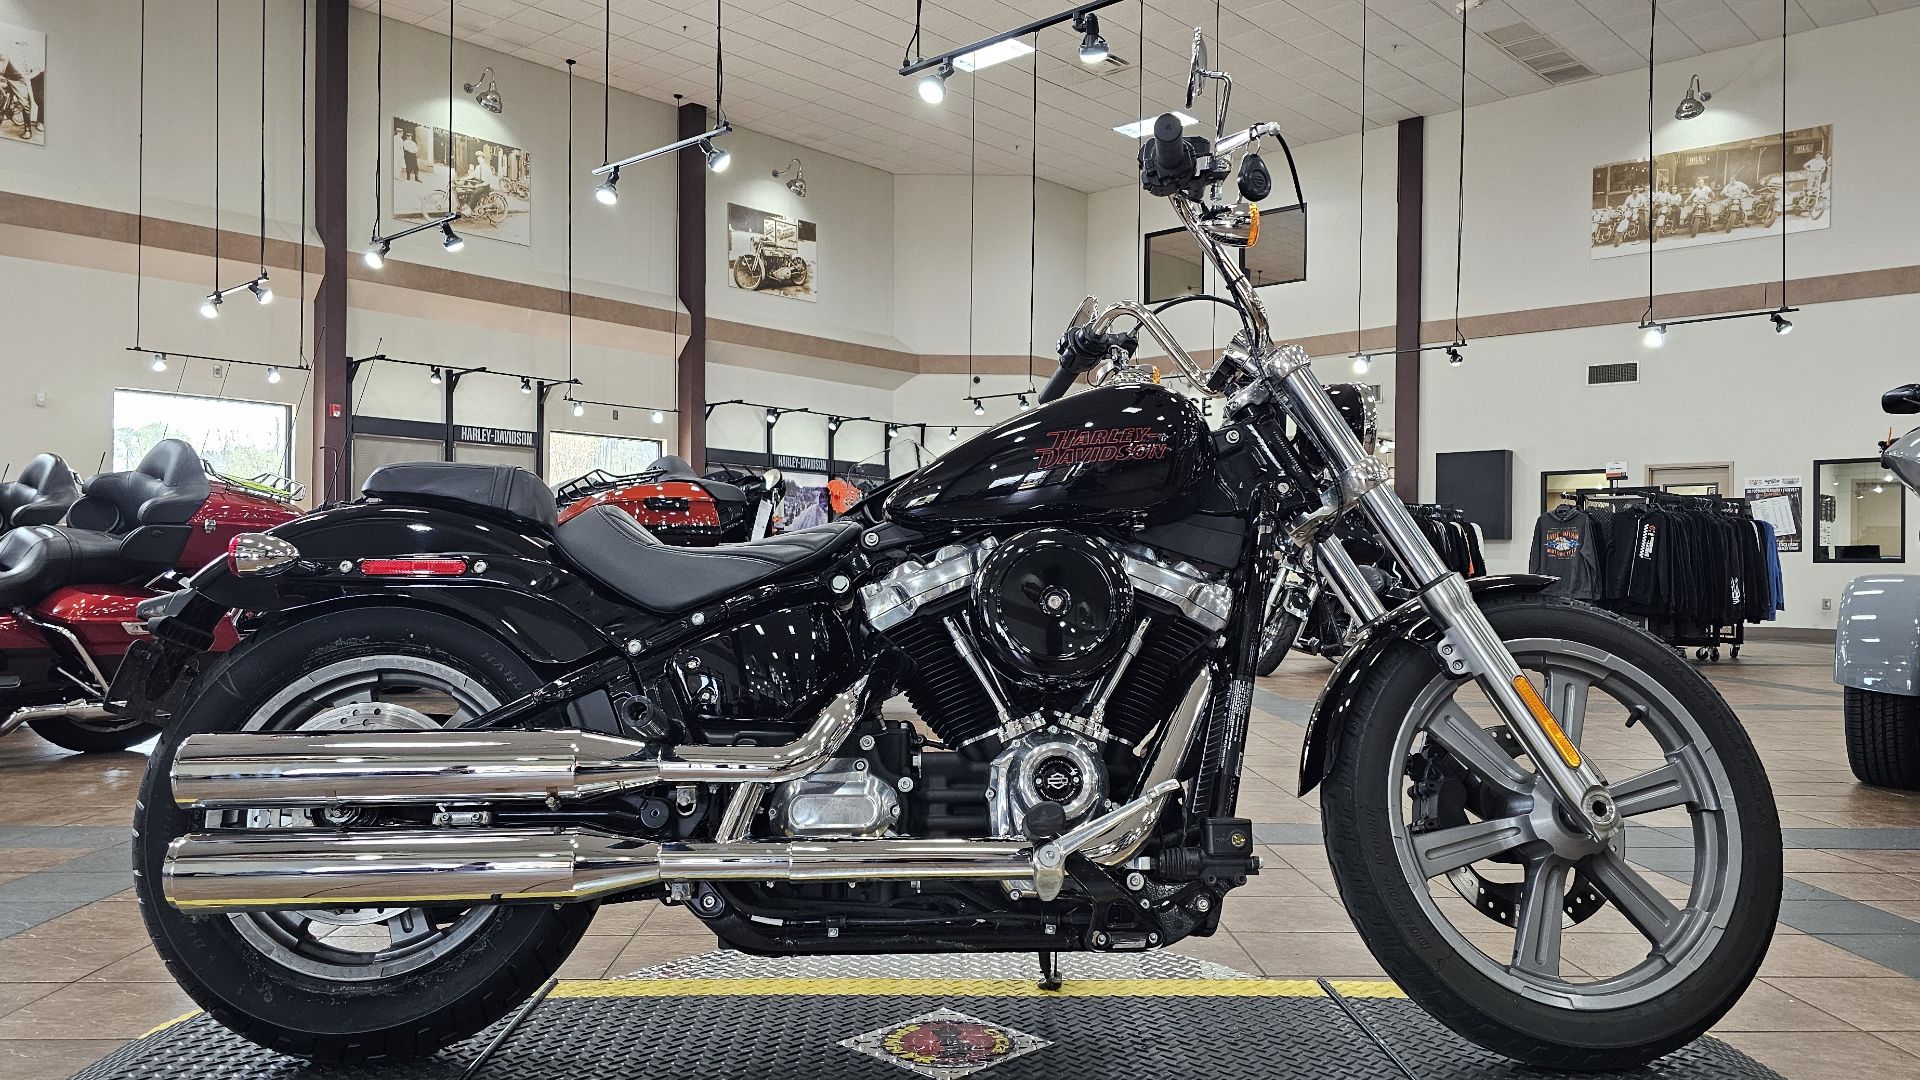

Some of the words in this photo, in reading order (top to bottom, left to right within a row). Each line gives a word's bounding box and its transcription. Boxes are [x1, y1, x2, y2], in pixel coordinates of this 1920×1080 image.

[461, 426, 533, 446] HARLEY-DAVIDSON
[778, 456, 827, 470] HARLEY-DAVIDSON
[1035, 443, 1167, 470] DAVIDSON
